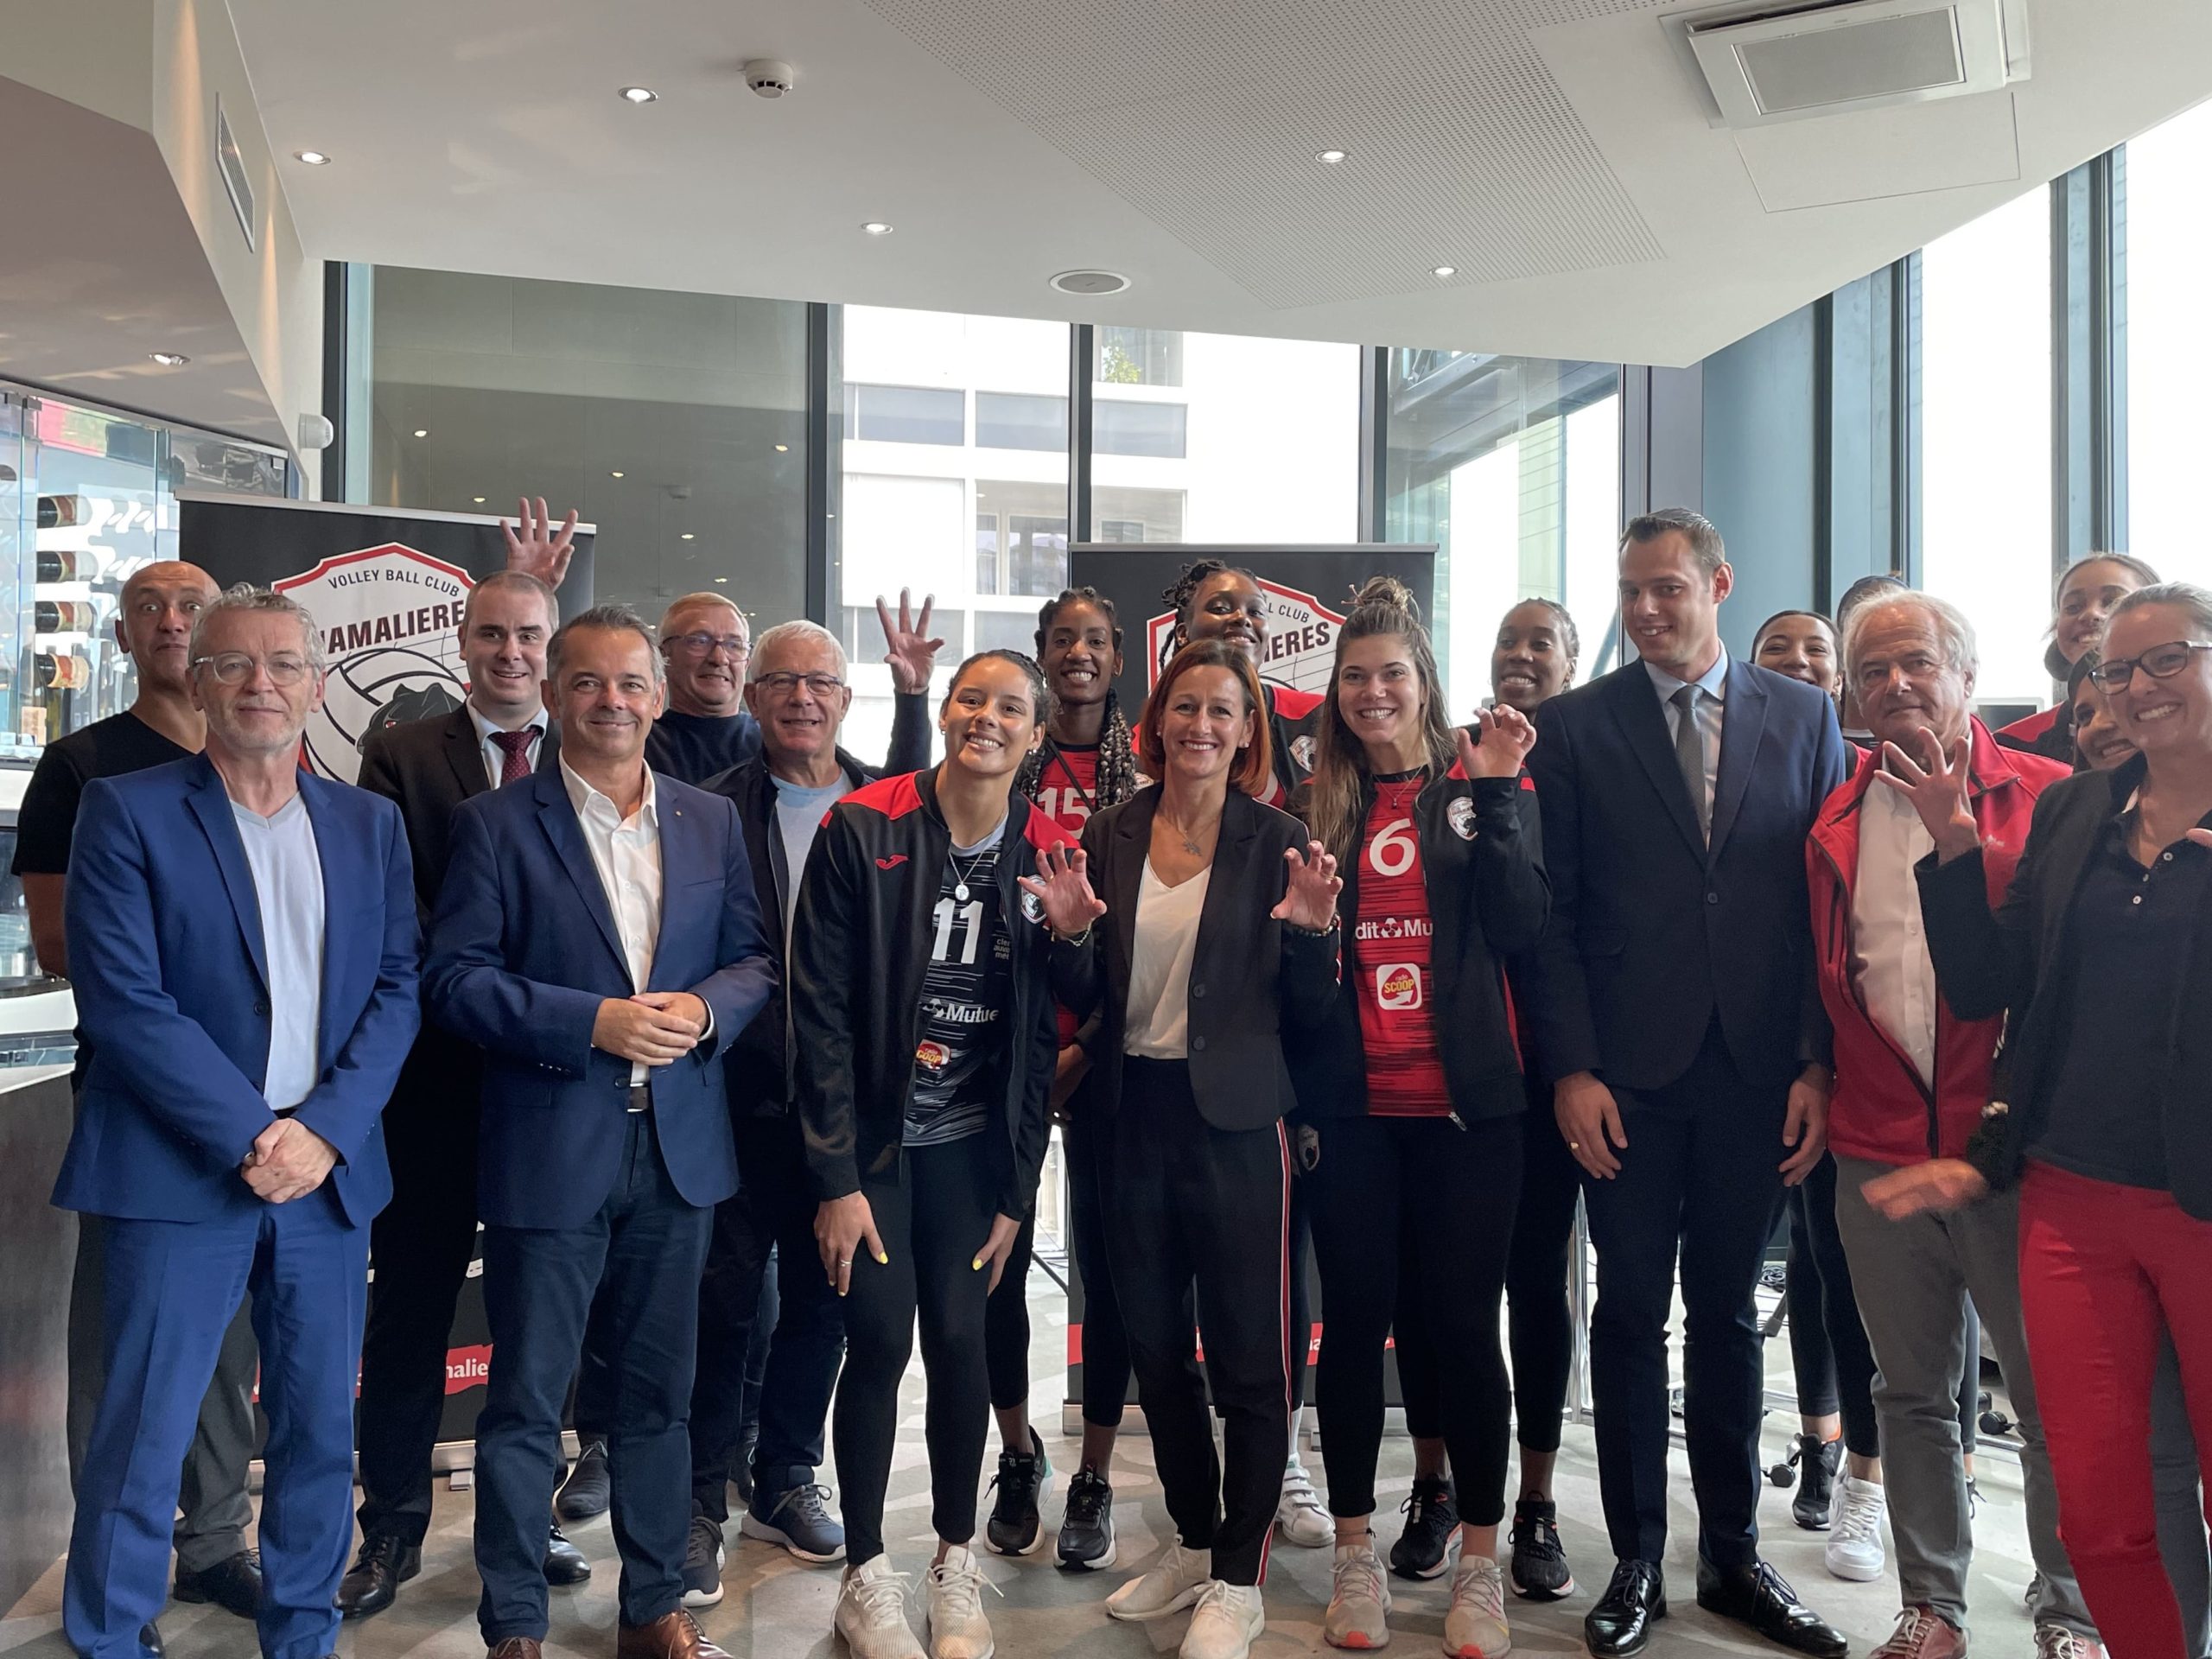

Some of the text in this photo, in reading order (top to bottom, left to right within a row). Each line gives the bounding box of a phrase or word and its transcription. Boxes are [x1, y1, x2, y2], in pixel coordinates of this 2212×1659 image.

[328, 569, 460, 597] VOLLEY BALL CLUB
[321, 600, 464, 654] AMALIERE
[1279, 605, 1309, 623] CLUB
[1037, 787, 1096, 840] 15
[1369, 817, 1416, 877] 6
[931, 897, 984, 964] 11
[1355, 919, 1433, 940] dit Mu
[1384, 979, 1414, 994] SCOOP
